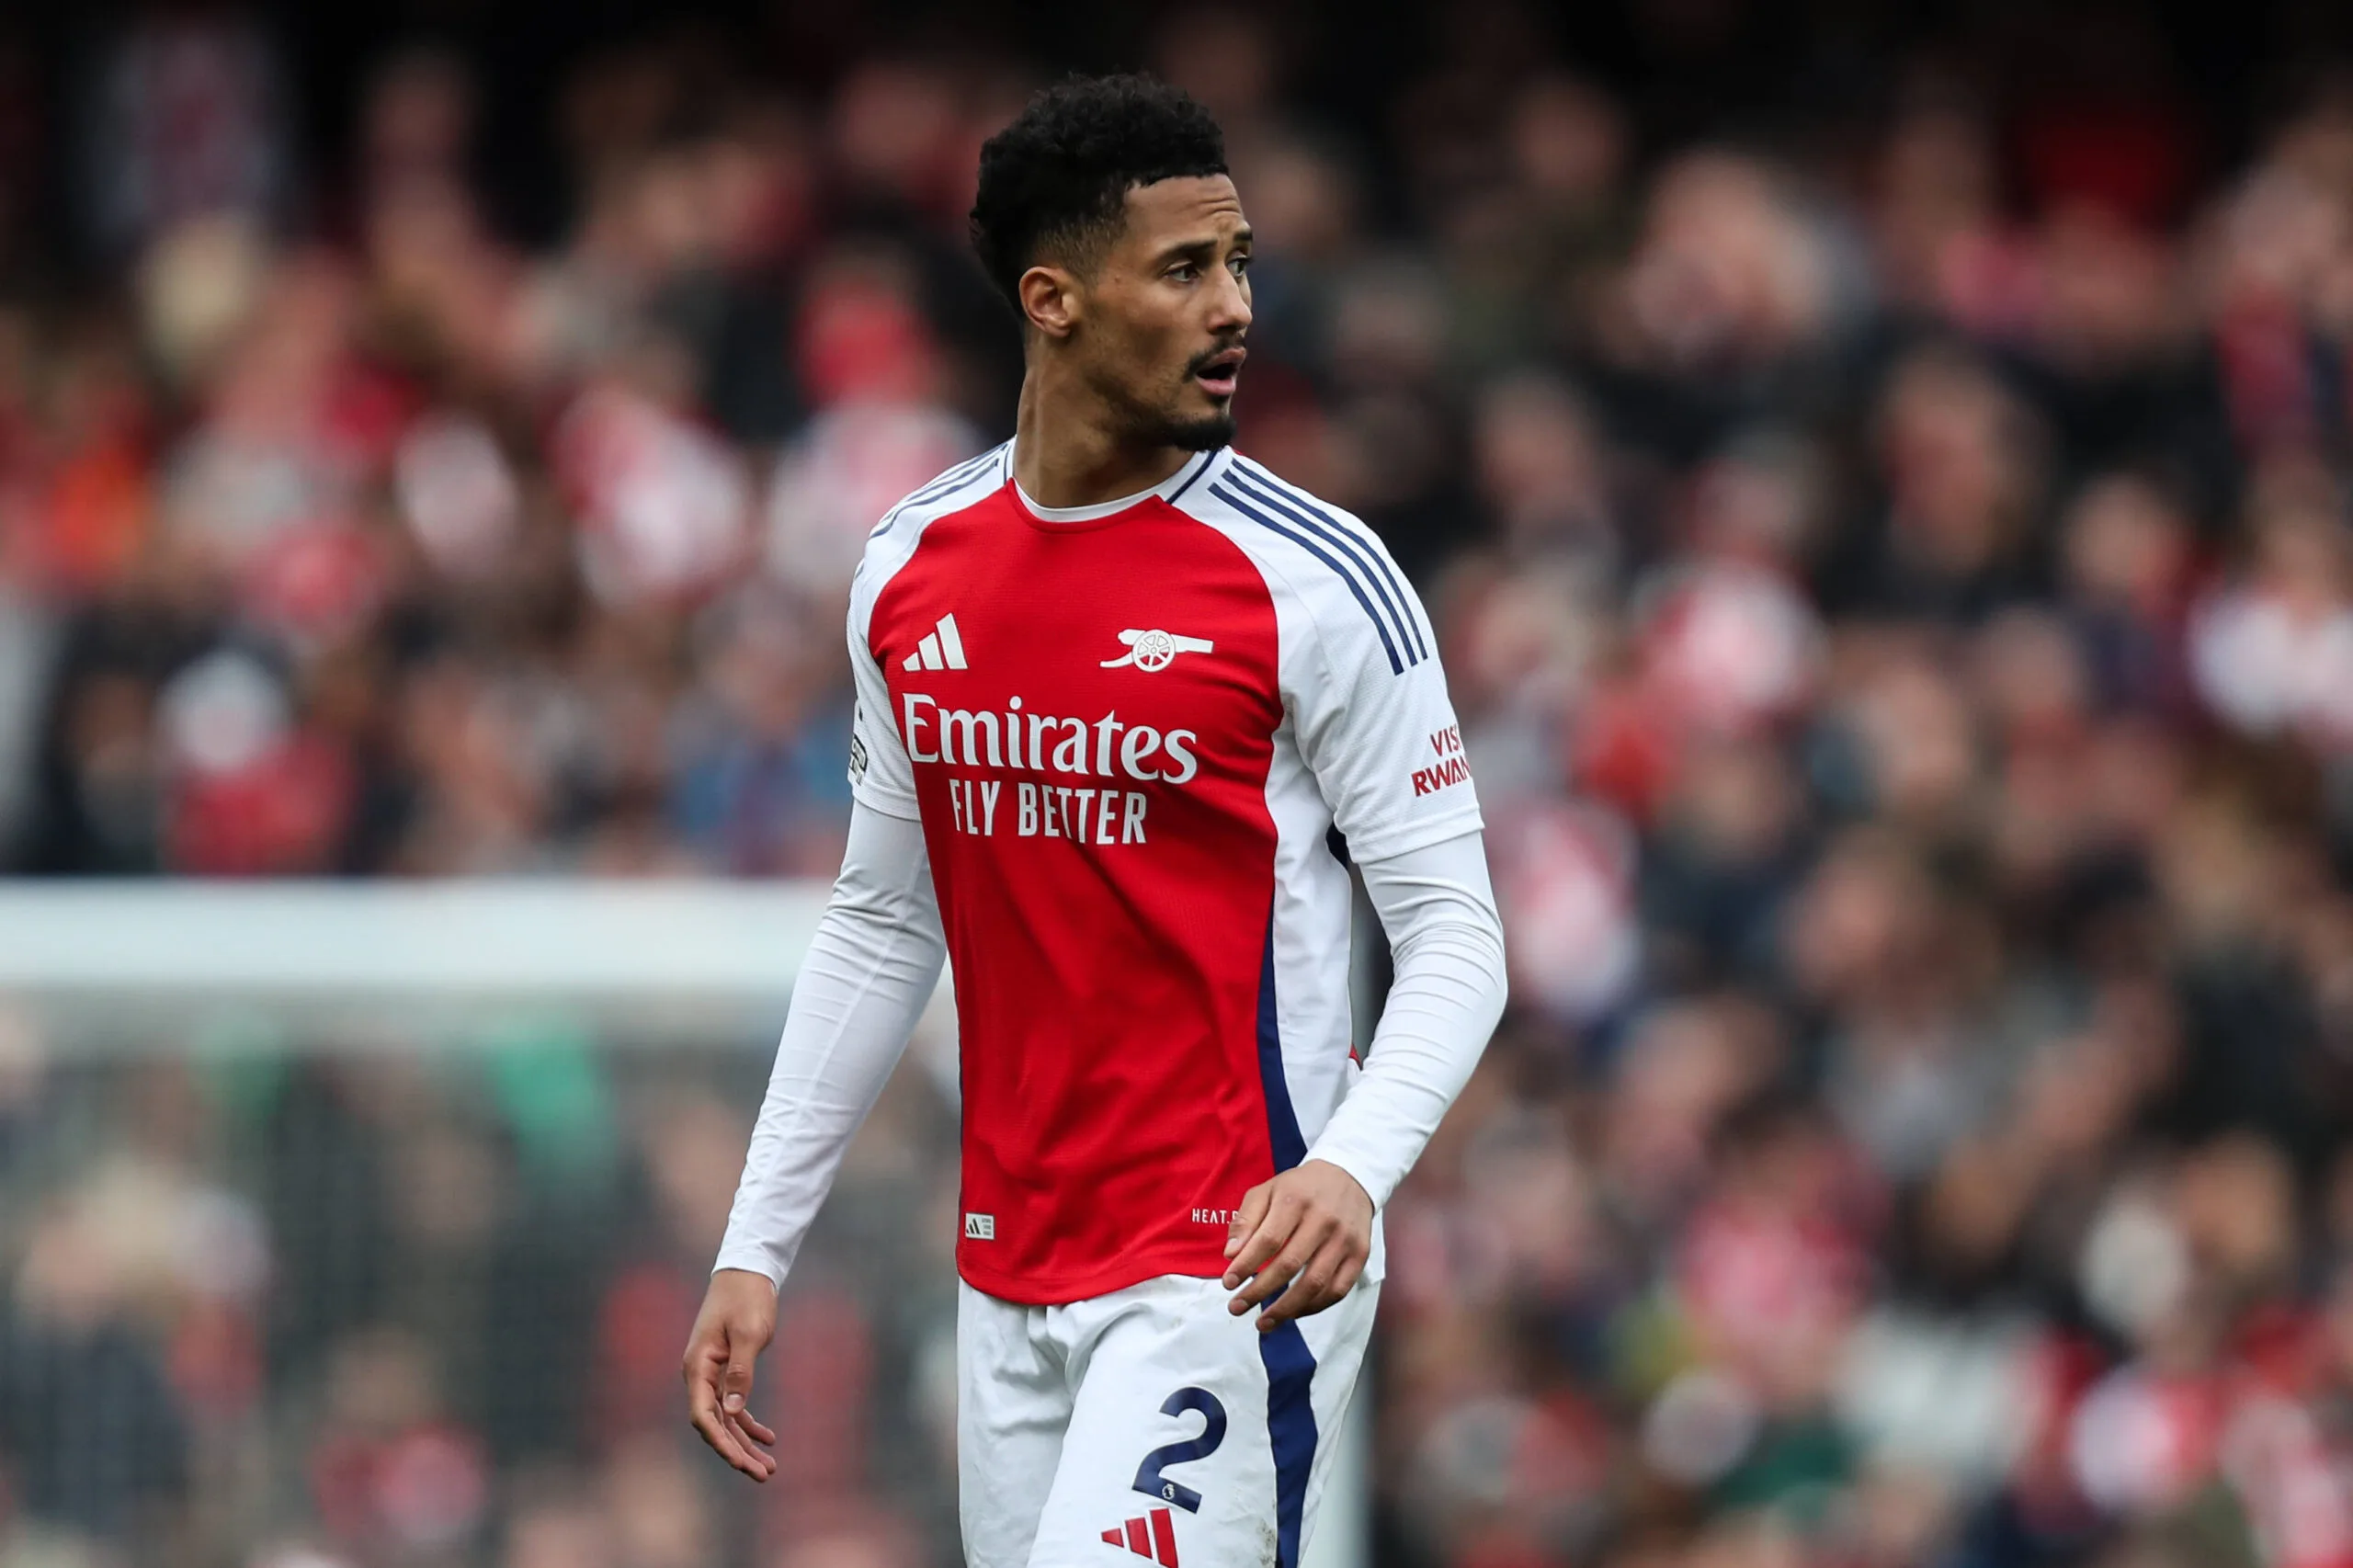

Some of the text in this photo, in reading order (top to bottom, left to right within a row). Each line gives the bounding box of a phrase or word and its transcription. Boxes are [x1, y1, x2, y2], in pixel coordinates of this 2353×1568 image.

[903, 692, 1198, 784] Emirates
[949, 778, 1147, 845] FLY BETTER
[1131, 1386, 1227, 1515] 2
